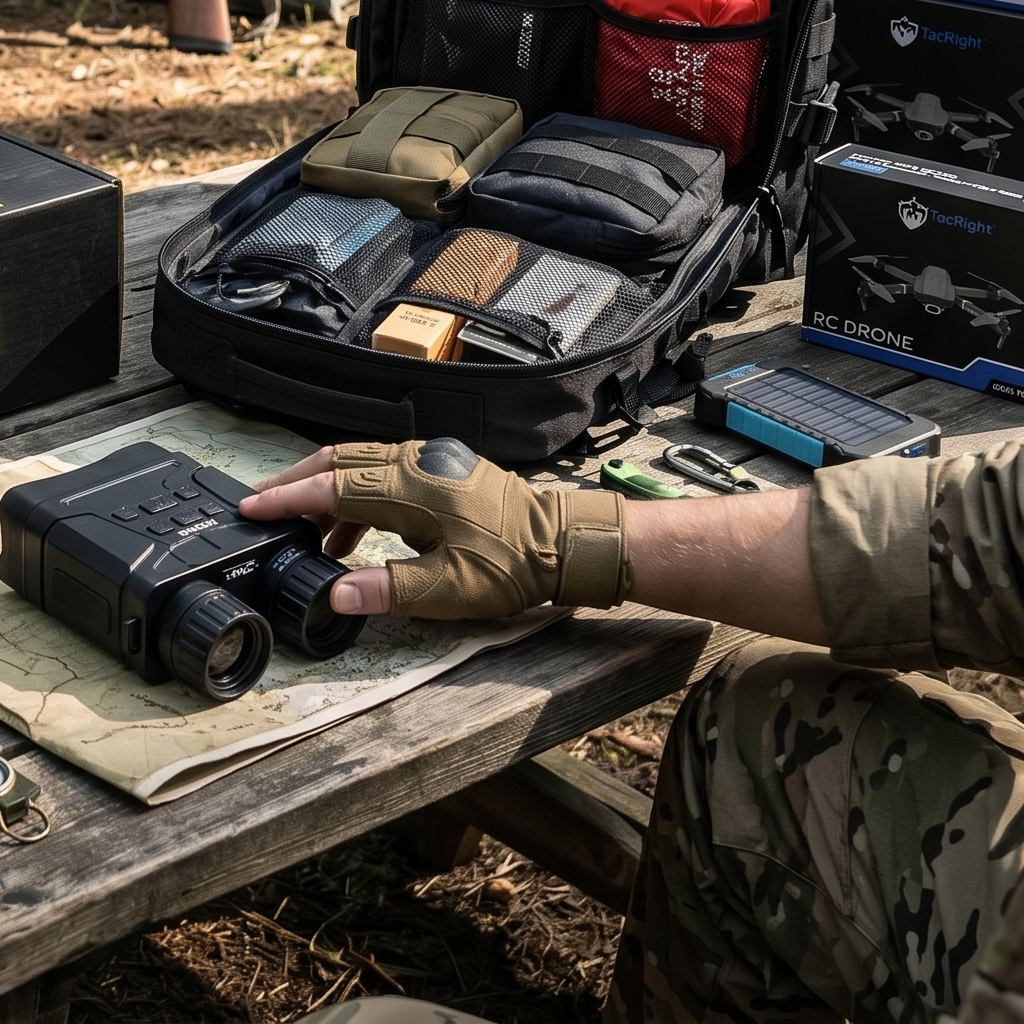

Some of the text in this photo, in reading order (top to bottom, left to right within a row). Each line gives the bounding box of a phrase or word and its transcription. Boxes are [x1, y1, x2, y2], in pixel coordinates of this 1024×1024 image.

[920, 26, 983, 50] TacRight
[930, 209, 993, 235] TacRight
[813, 311, 914, 351] RC DRONE
